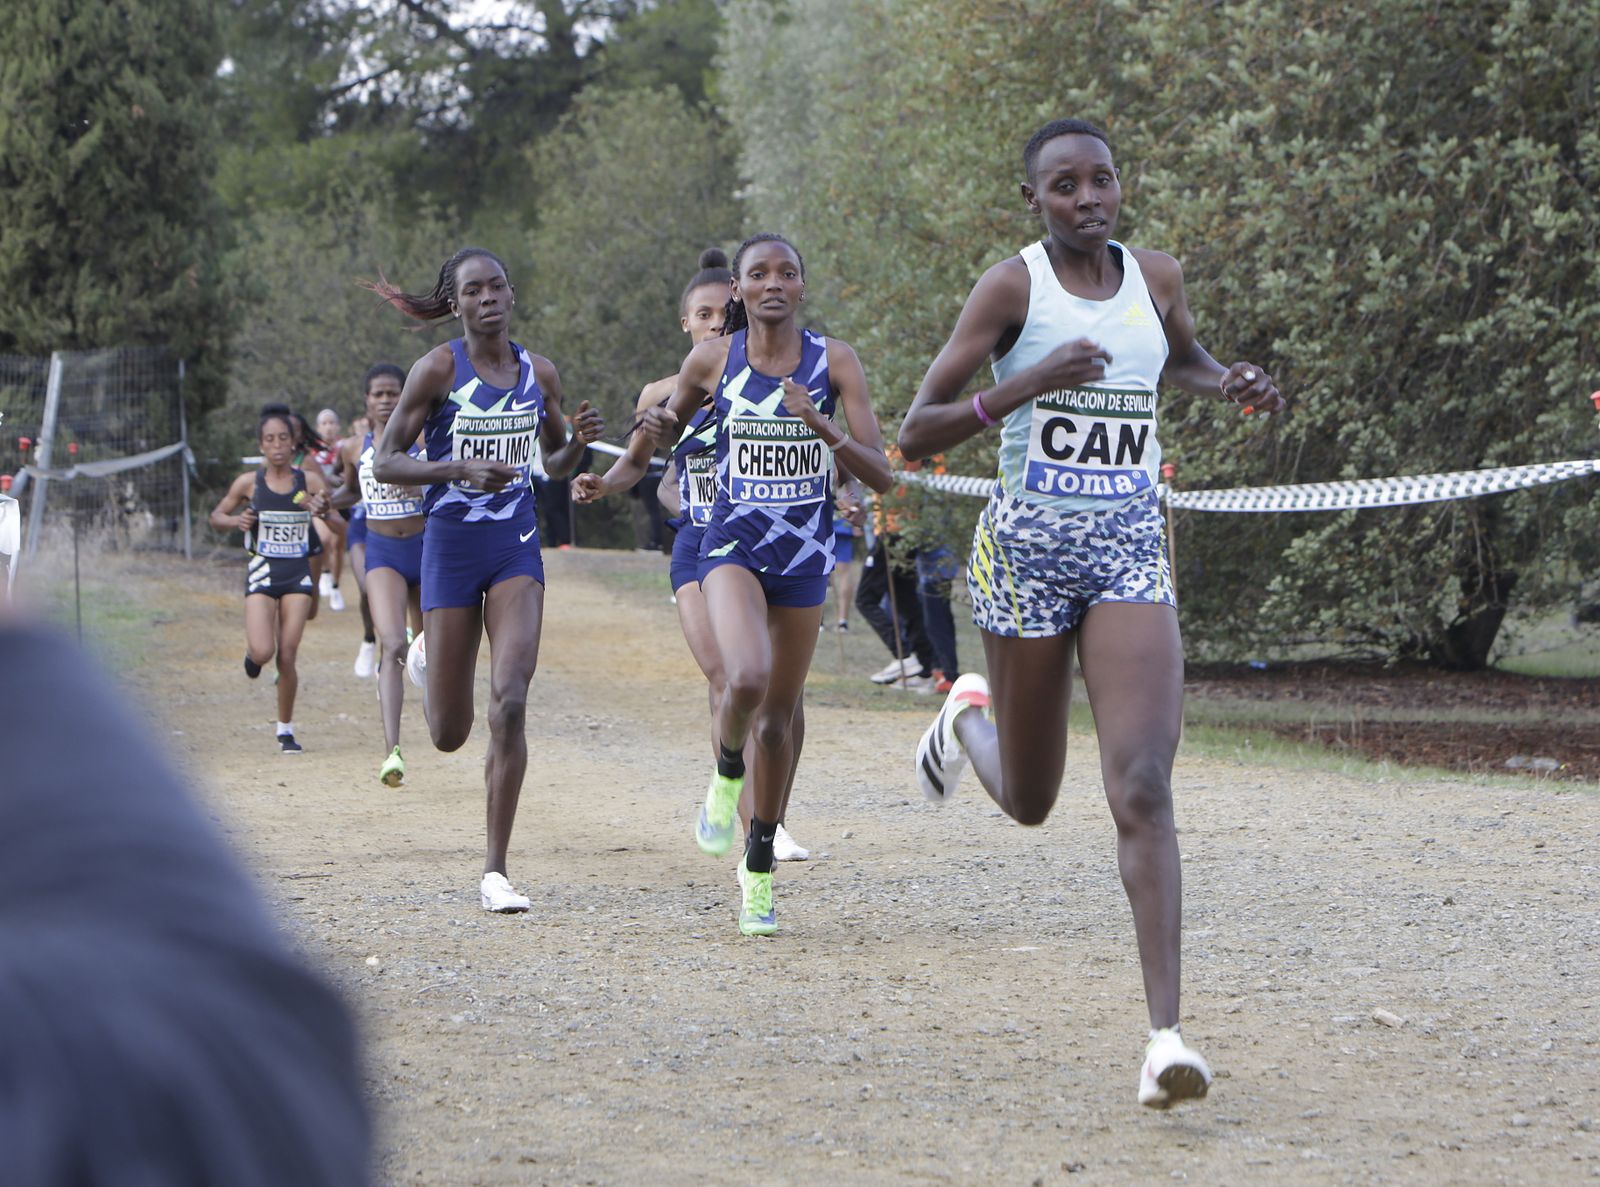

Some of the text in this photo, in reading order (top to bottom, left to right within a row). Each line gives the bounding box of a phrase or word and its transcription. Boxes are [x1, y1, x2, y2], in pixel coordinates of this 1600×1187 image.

[1107, 393, 1121, 411] DE
[1122, 394, 1154, 413] SEVILLA
[456, 417, 502, 431] DIPUTACION
[503, 418, 513, 430] DE
[732, 421, 784, 436] DIPUTACION
[786, 423, 797, 436] DE
[460, 434, 530, 465] CHELIMO
[1041, 416, 1149, 466] CAN
[738, 442, 822, 477] CHERONO
[370, 502, 415, 516] Joma
[264, 525, 305, 542] TESFU
